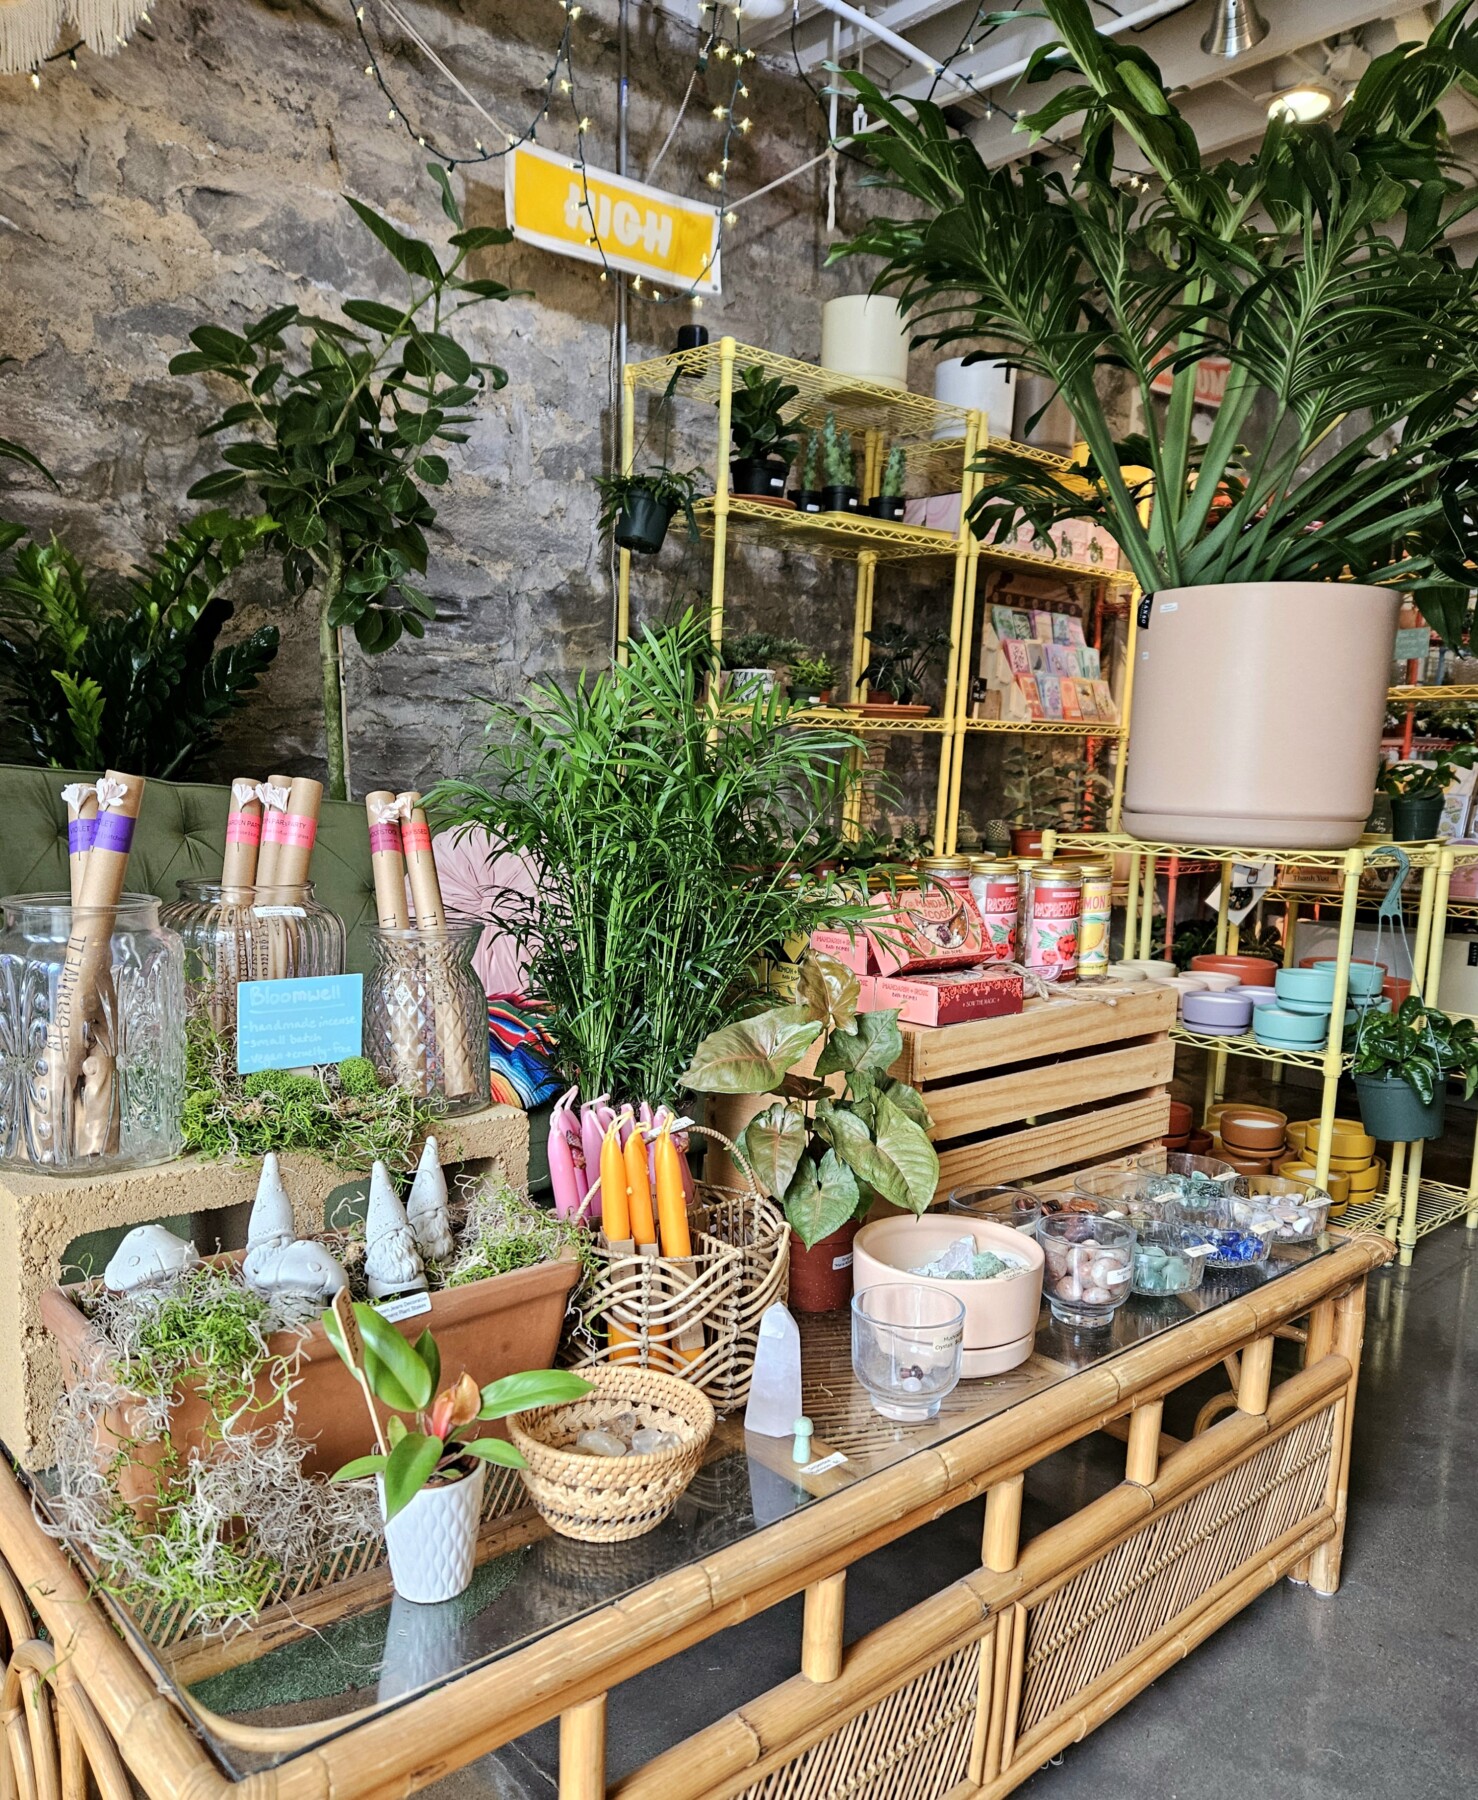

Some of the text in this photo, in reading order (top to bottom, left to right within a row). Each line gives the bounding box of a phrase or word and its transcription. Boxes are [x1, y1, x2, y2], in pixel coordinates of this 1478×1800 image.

[564, 182, 673, 258] HIGH
[1141, 599, 1150, 624] KANSO
[1293, 874, 1330, 882] Thank You
[1034, 899, 1077, 917] RASPBERRY
[249, 985, 341, 1007] Bloomwell
[319, 1015, 358, 1028] incense
[289, 1032, 322, 1044] batch
